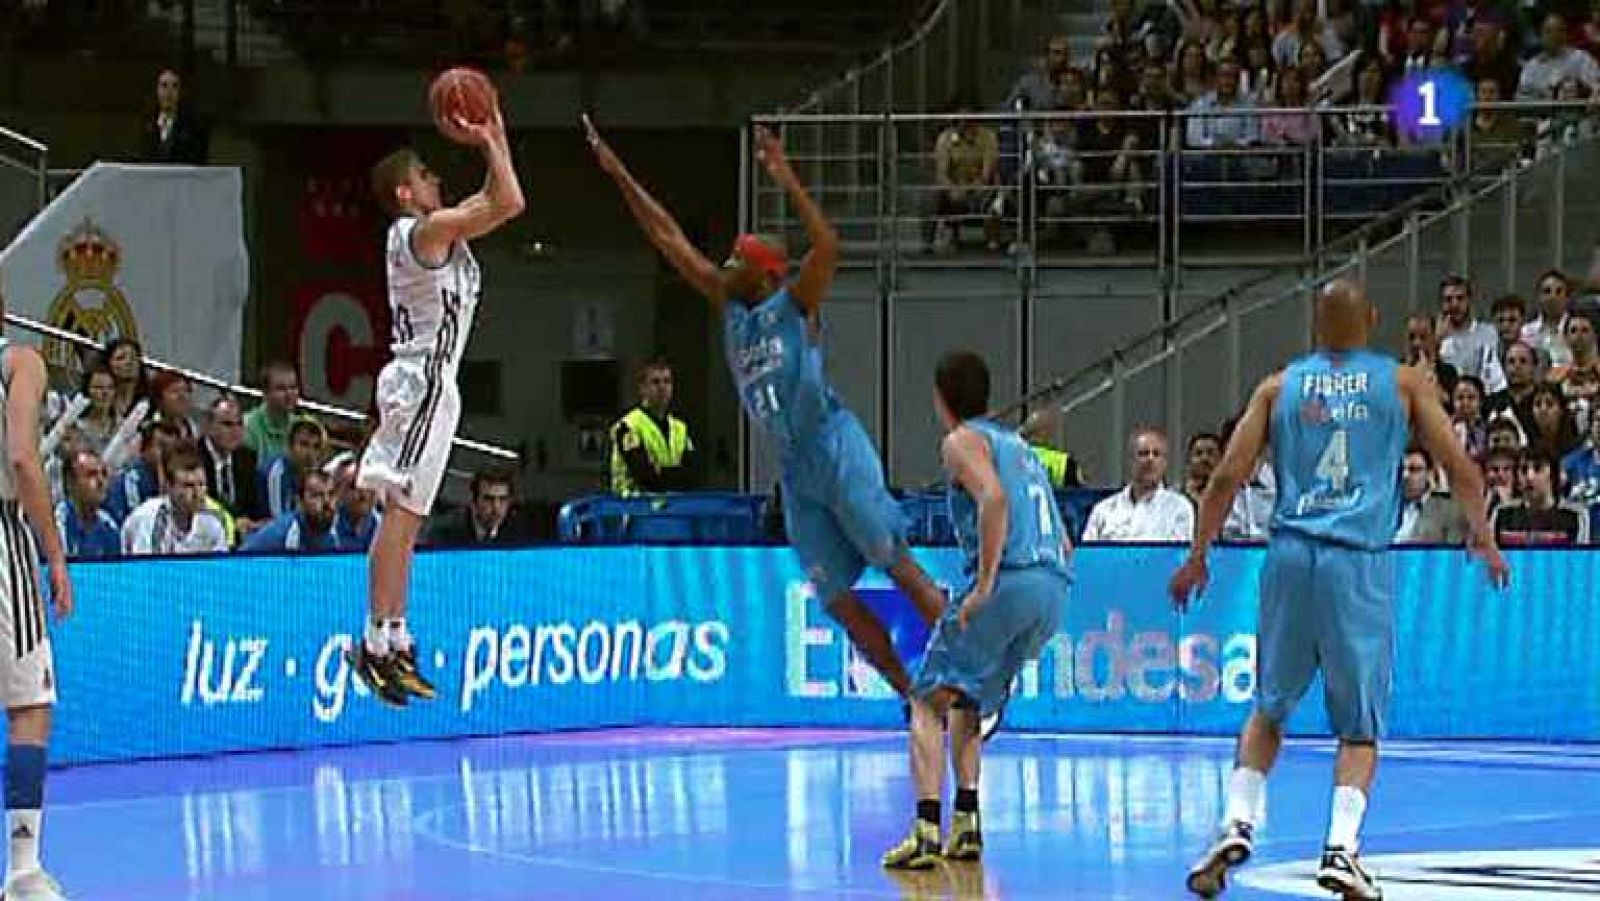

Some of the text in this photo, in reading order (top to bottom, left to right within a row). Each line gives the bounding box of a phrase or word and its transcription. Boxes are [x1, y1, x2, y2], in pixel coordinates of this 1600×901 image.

[1316, 430, 1349, 491] 4
[181, 619, 268, 705] luz
[461, 618, 730, 713] personas
